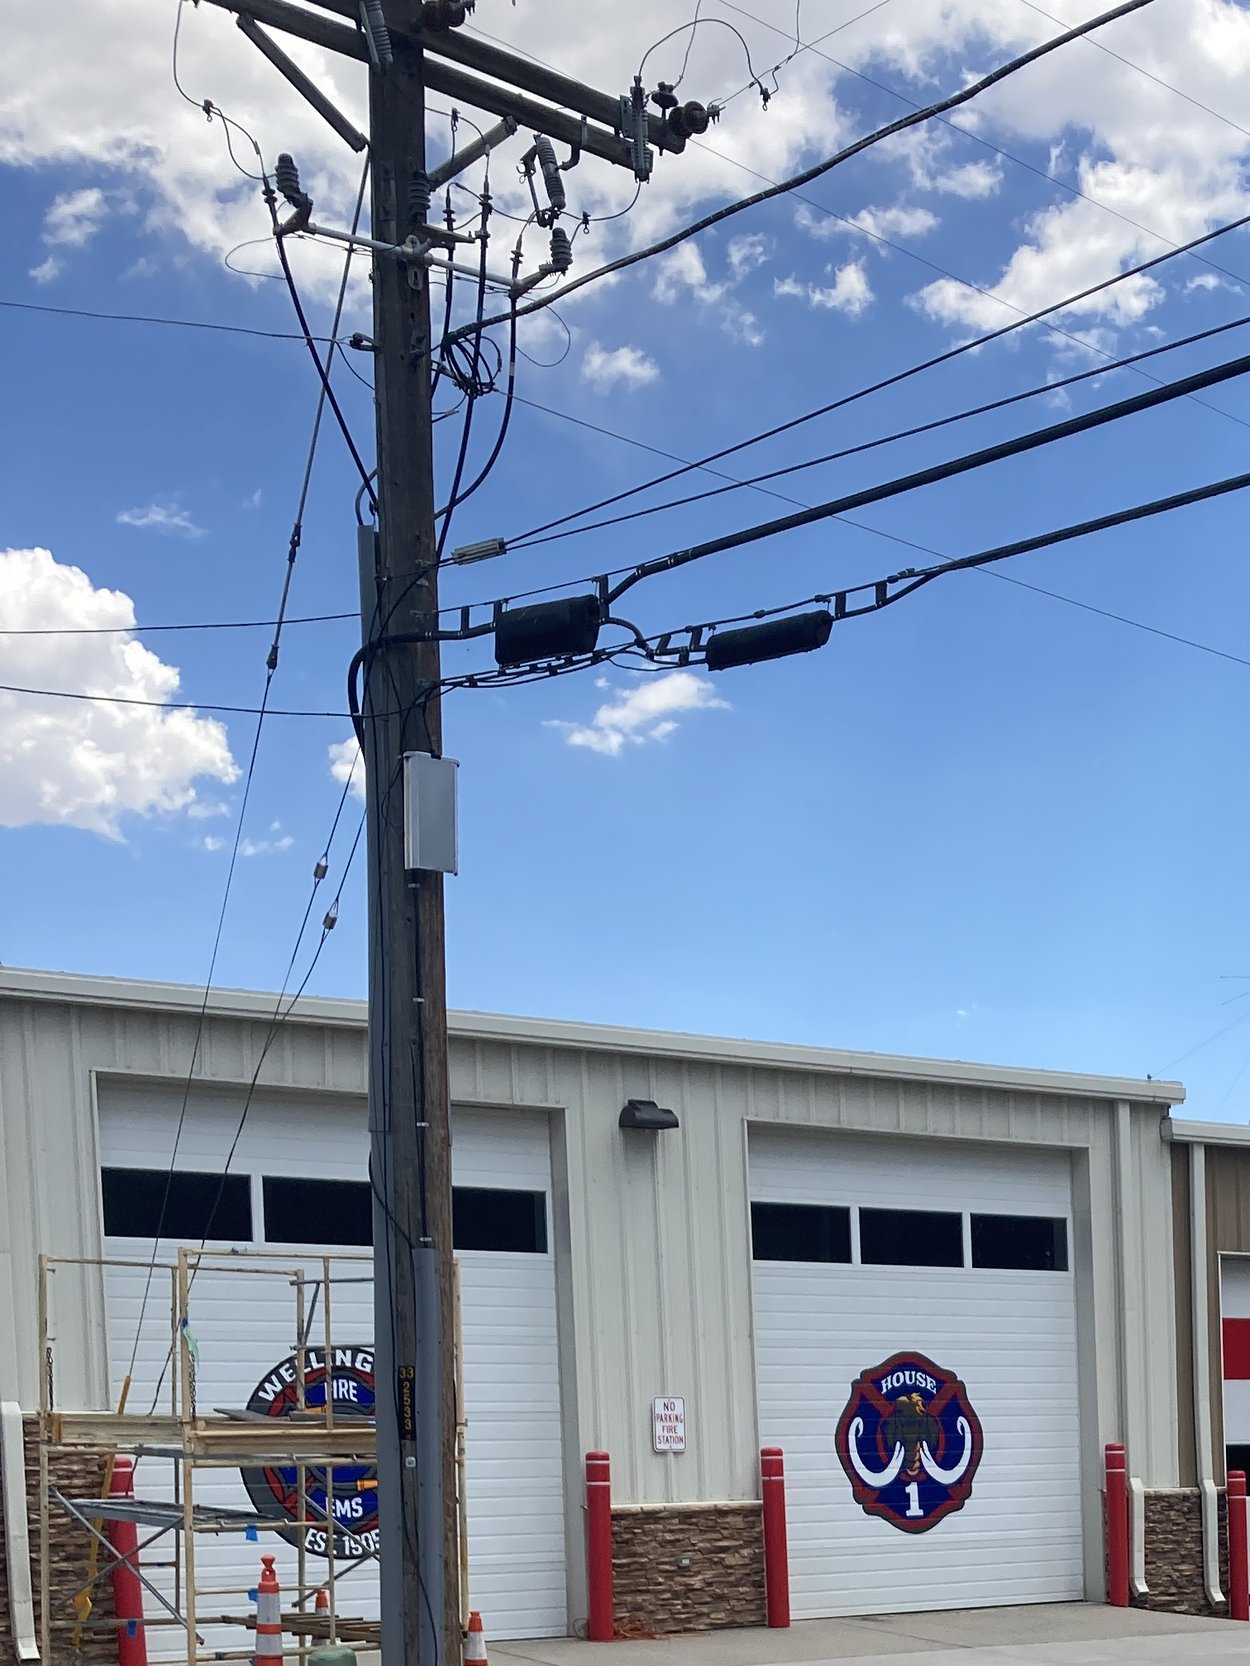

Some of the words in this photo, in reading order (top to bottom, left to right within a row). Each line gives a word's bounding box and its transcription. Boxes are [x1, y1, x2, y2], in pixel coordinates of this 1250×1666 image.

[258, 1349, 374, 1402] WELNG
[881, 1370, 937, 1395] HOUSE
[663, 1401, 676, 1411] NO
[656, 1413, 684, 1423] PARKING
[662, 1425, 678, 1434] FIRE
[658, 1435, 684, 1444] STATION
[905, 1481, 924, 1517] 1
[325, 1496, 364, 1519] EMS
